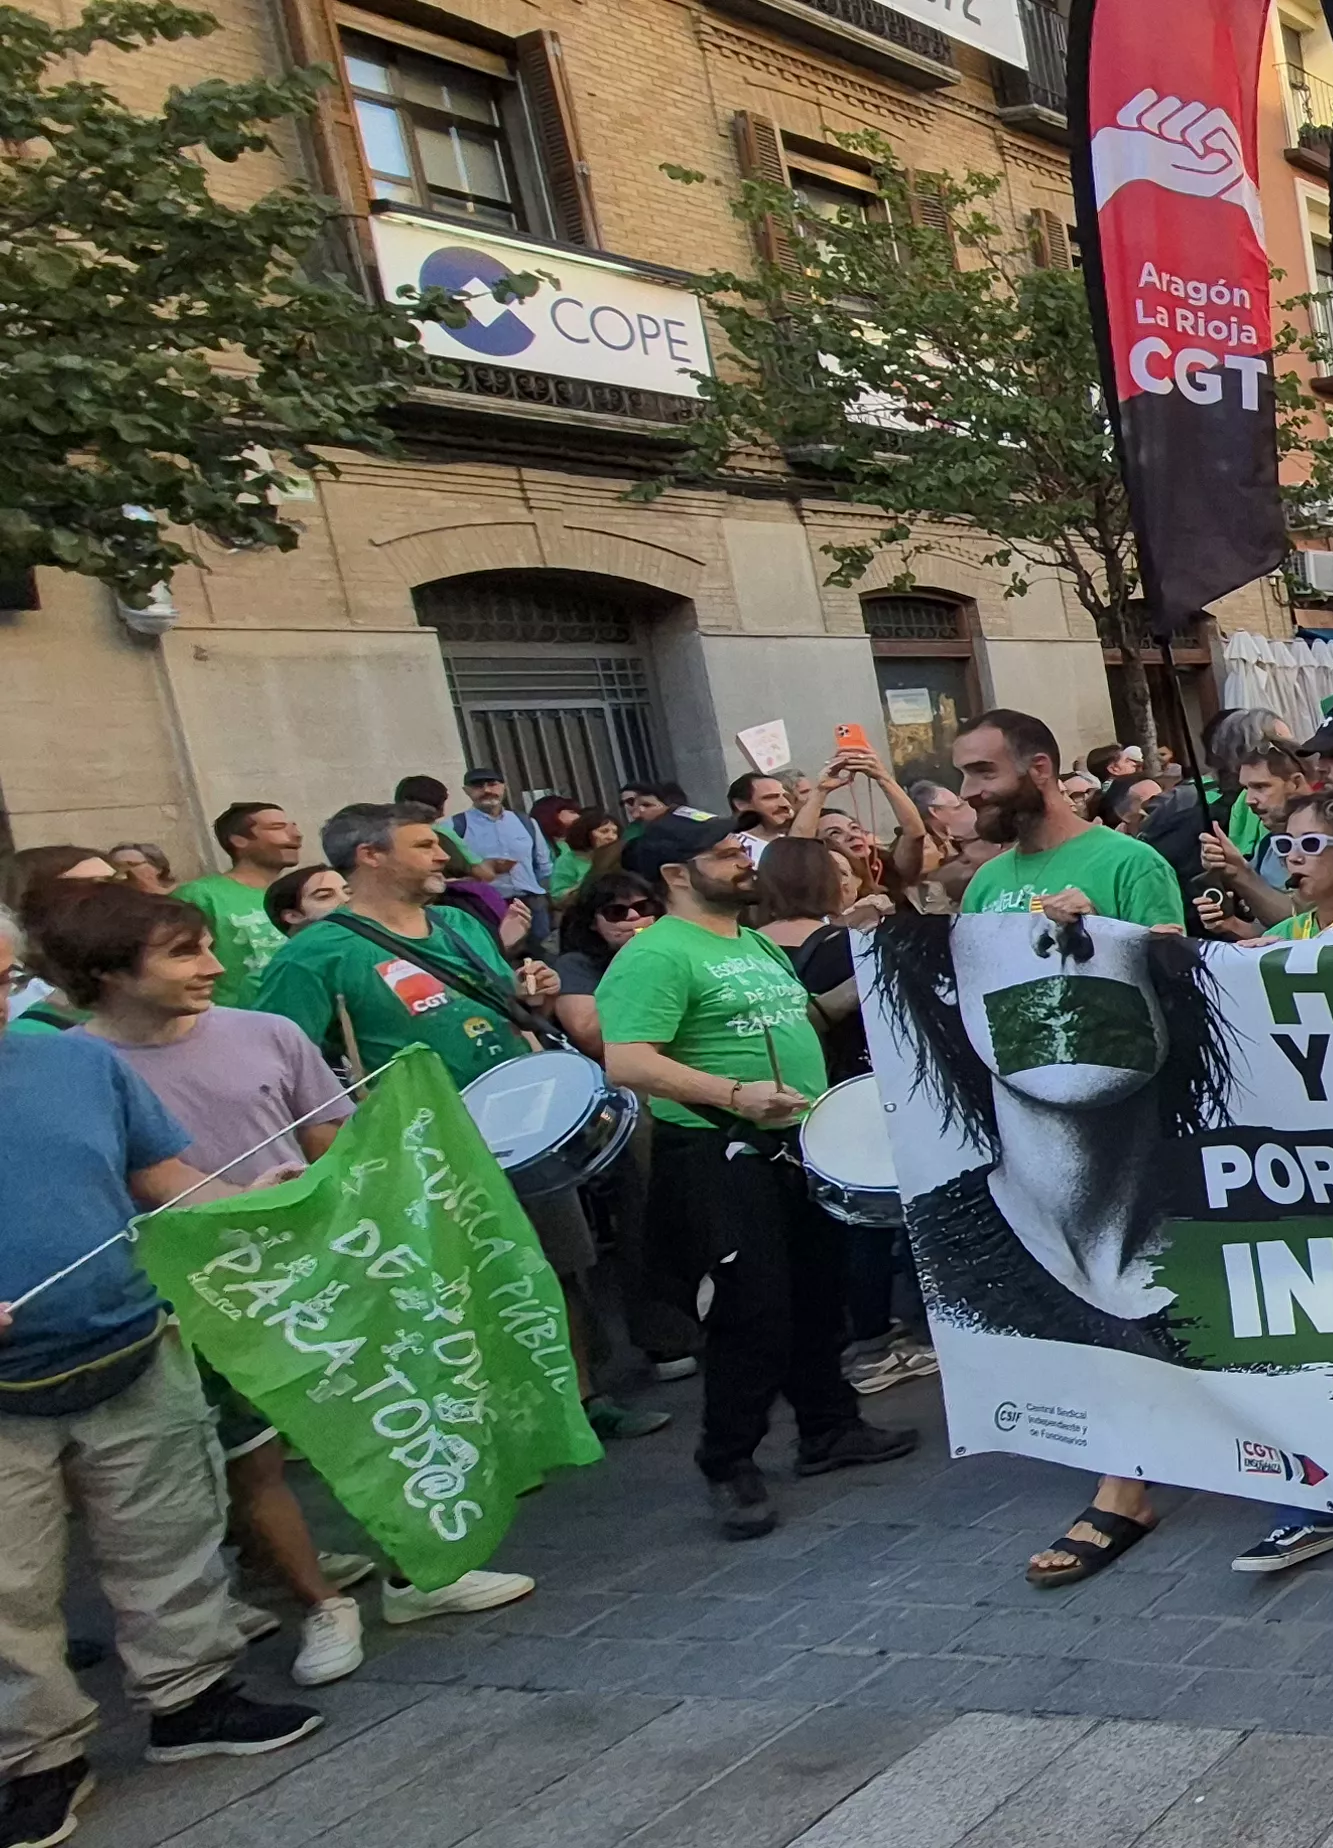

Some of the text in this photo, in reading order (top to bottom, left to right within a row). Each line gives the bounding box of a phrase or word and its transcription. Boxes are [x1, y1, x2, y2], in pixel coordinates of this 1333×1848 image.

[1138, 261, 1252, 310] Aragón
[550, 296, 693, 364] COPE
[1135, 298, 1258, 346] La Rioja
[1128, 336, 1268, 412] CGT
[412, 993, 449, 1013] CGT
[1270, 1033, 1330, 1102] Y
[329, 1217, 427, 1279] DE
